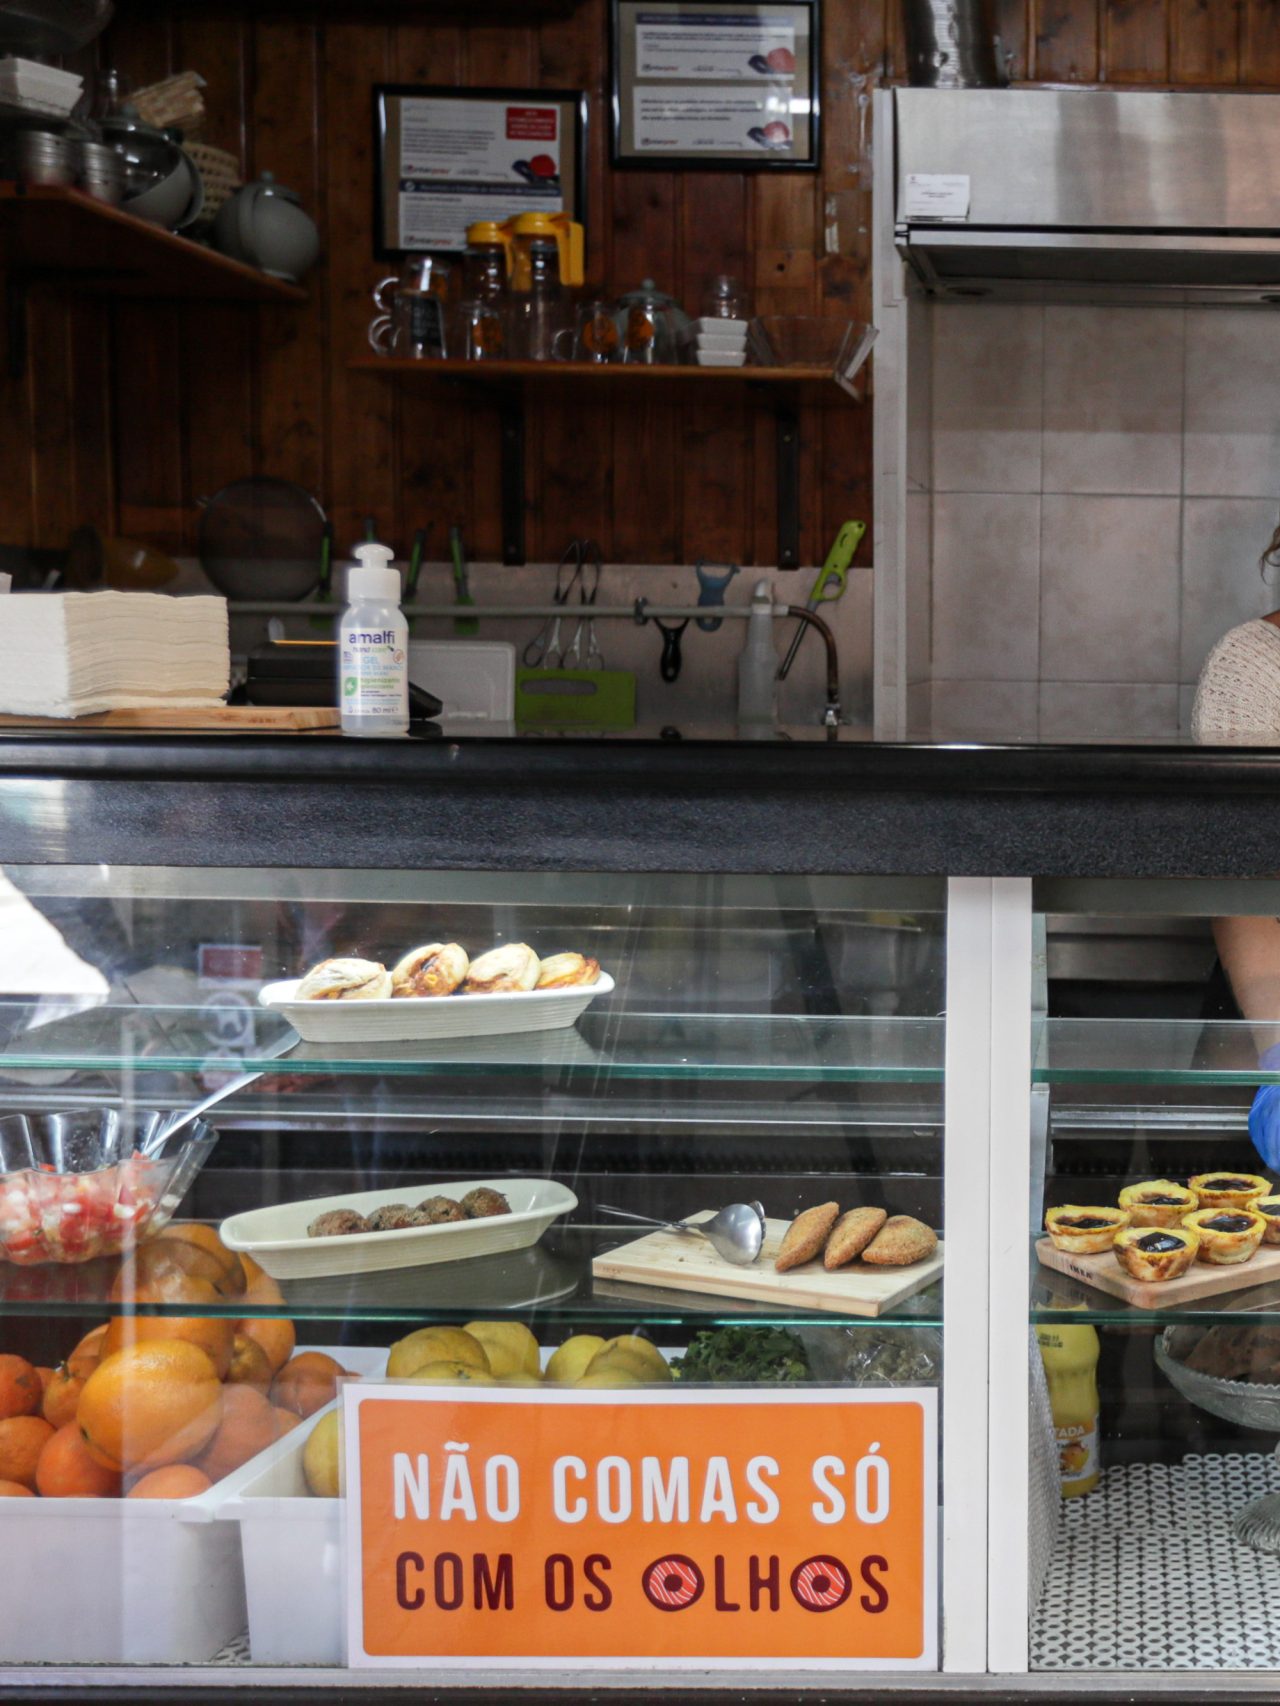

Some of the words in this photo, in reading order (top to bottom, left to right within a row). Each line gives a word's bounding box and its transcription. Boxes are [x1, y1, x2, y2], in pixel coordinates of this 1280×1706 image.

[348, 630, 395, 644] amalfi
[393, 1441, 520, 1523] NÃO
[553, 1455, 780, 1524] COMAS
[812, 1442, 890, 1524] SÓ
[396, 1551, 514, 1611] COM
[544, 1553, 613, 1612] OS
[641, 1553, 889, 1614] OLHOS
